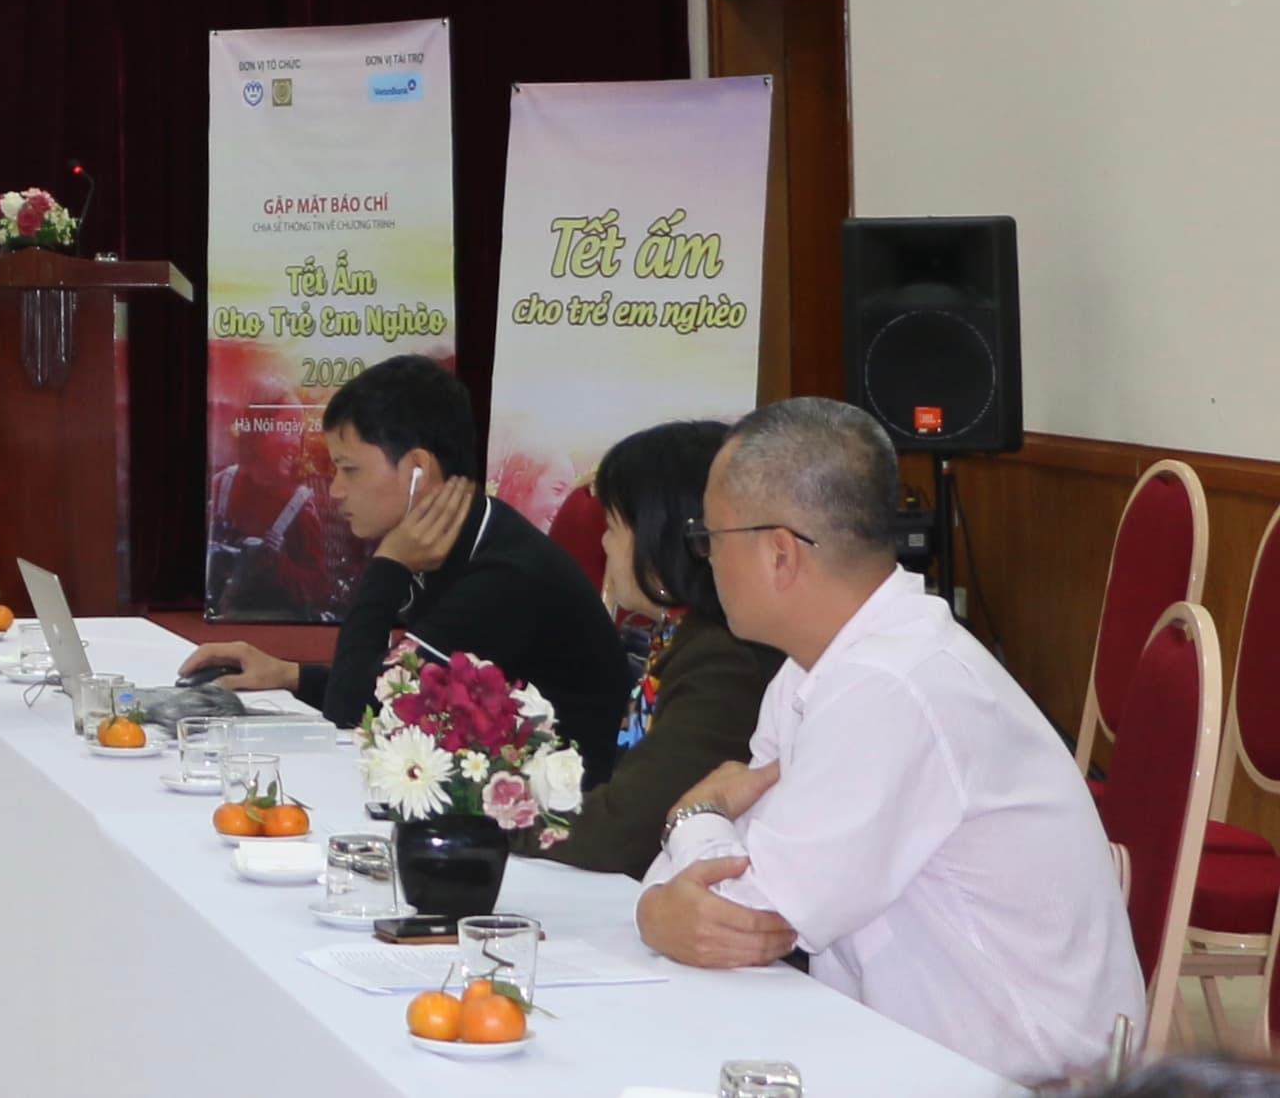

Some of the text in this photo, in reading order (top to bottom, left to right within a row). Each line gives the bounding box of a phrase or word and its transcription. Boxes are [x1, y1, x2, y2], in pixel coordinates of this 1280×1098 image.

[263, 192, 388, 218] GẶP MẶT BÁO CHÍ
[551, 208, 723, 278] Tết ấm
[285, 249, 378, 296] Tết Ấm
[214, 302, 448, 343] Cho Trẻ Em Nghèo
[512, 291, 747, 334] cho trẻ em nghèo
[302, 358, 365, 388] 2020
[235, 418, 250, 431] Hà
[253, 418, 274, 433] Nội
[277, 418, 304, 435] ngày
